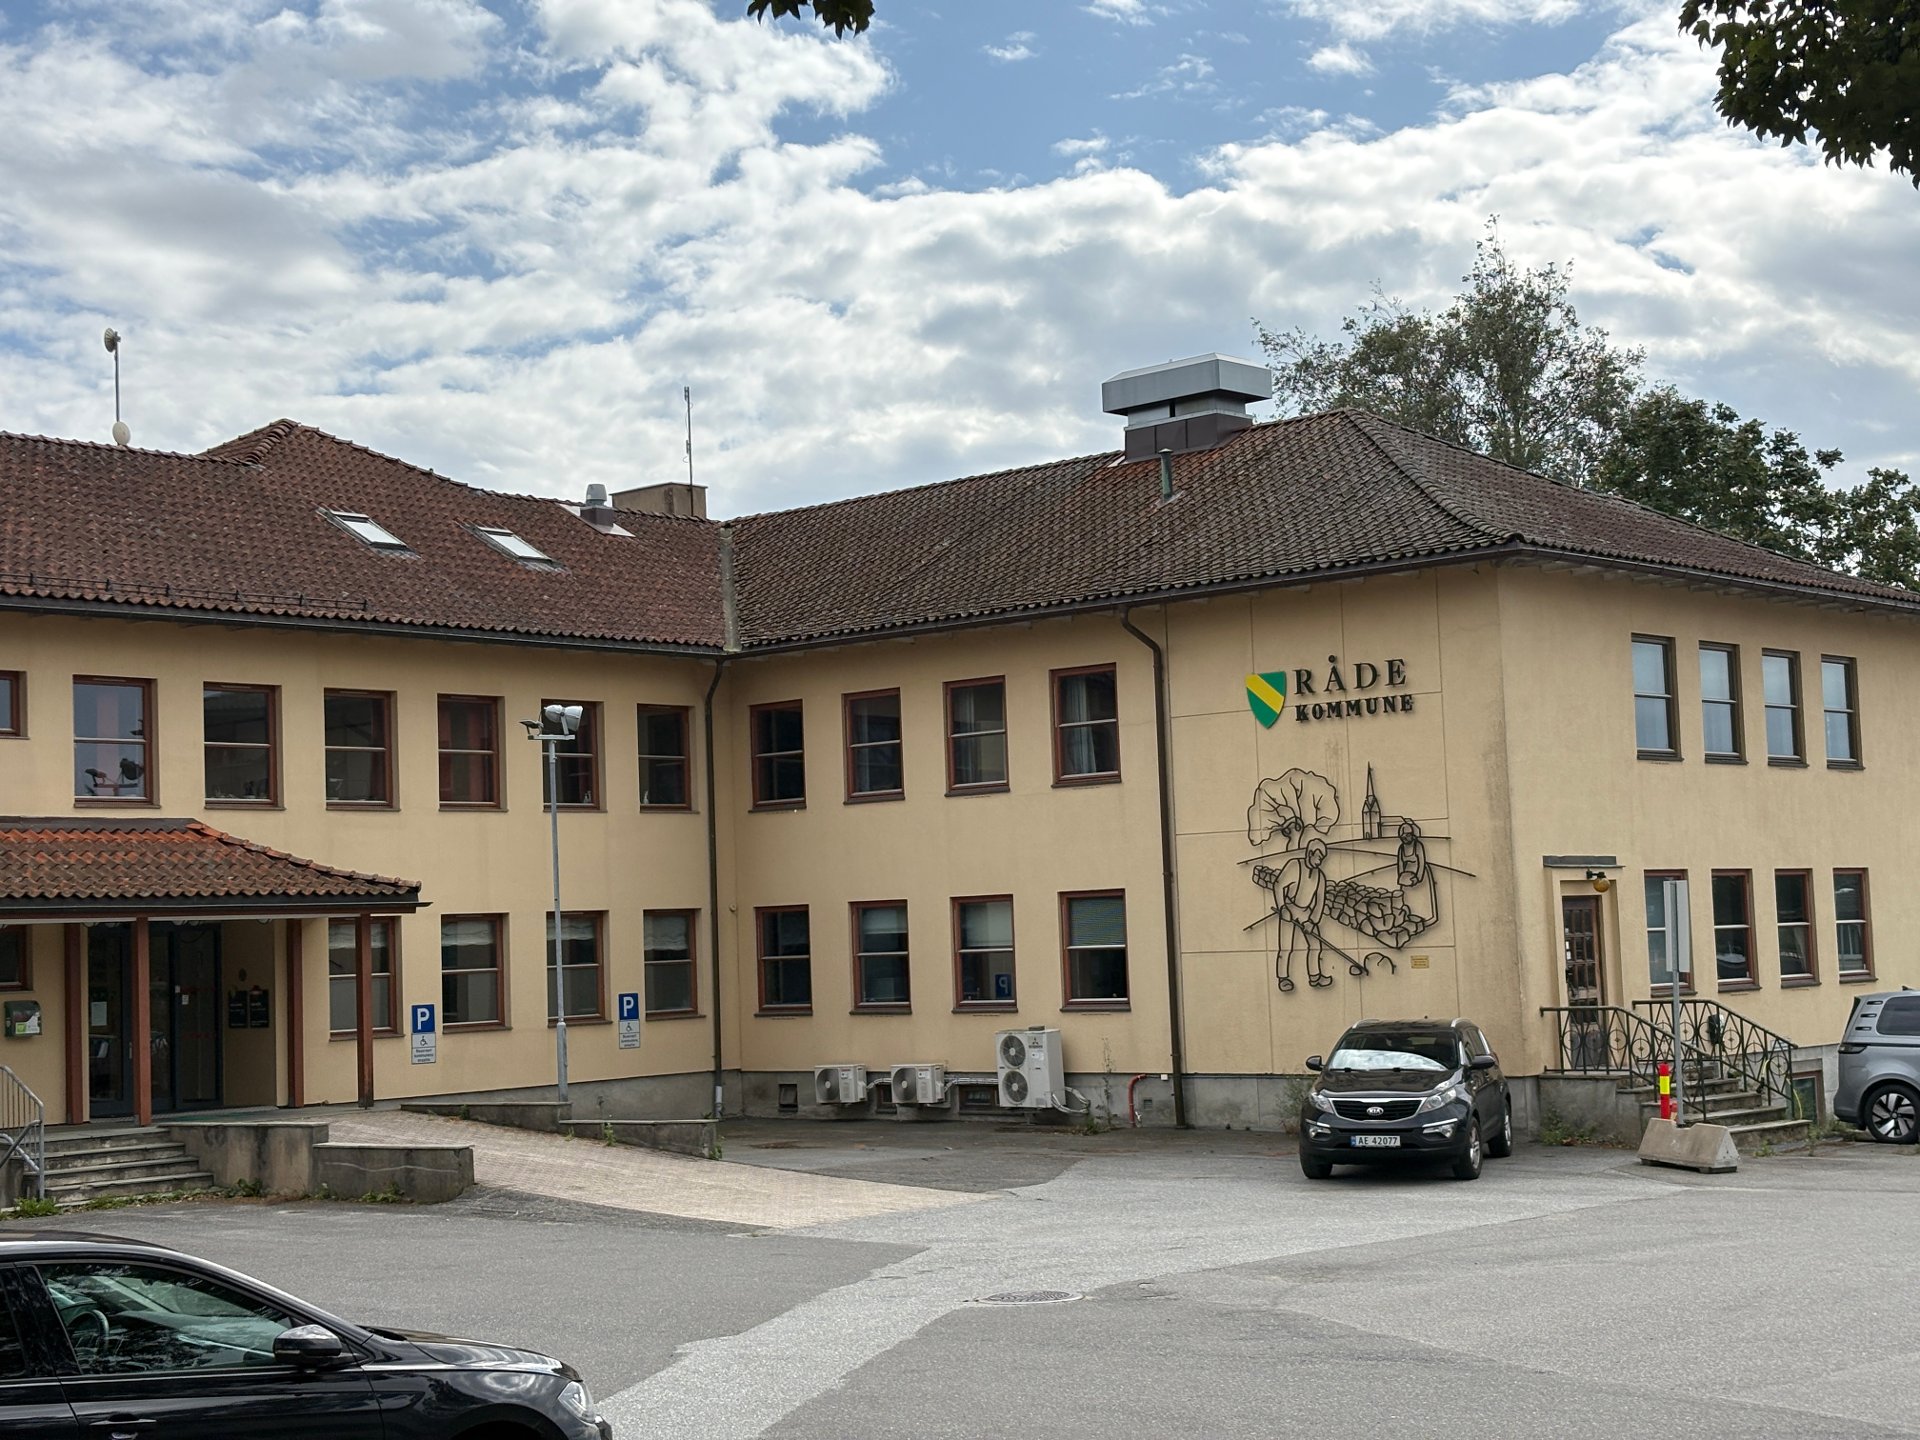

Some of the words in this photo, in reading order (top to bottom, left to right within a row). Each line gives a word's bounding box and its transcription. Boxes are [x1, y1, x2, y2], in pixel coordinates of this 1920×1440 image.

[1293, 655, 1407, 696] RÅDE
[1295, 695, 1414, 722] KOMMUNE
[623, 996, 635, 1017] P
[417, 1007, 430, 1031] P
[1367, 1107, 1384, 1115] KIA
[1358, 1136, 1370, 1145] AE
[1371, 1136, 1398, 1145] 42077
